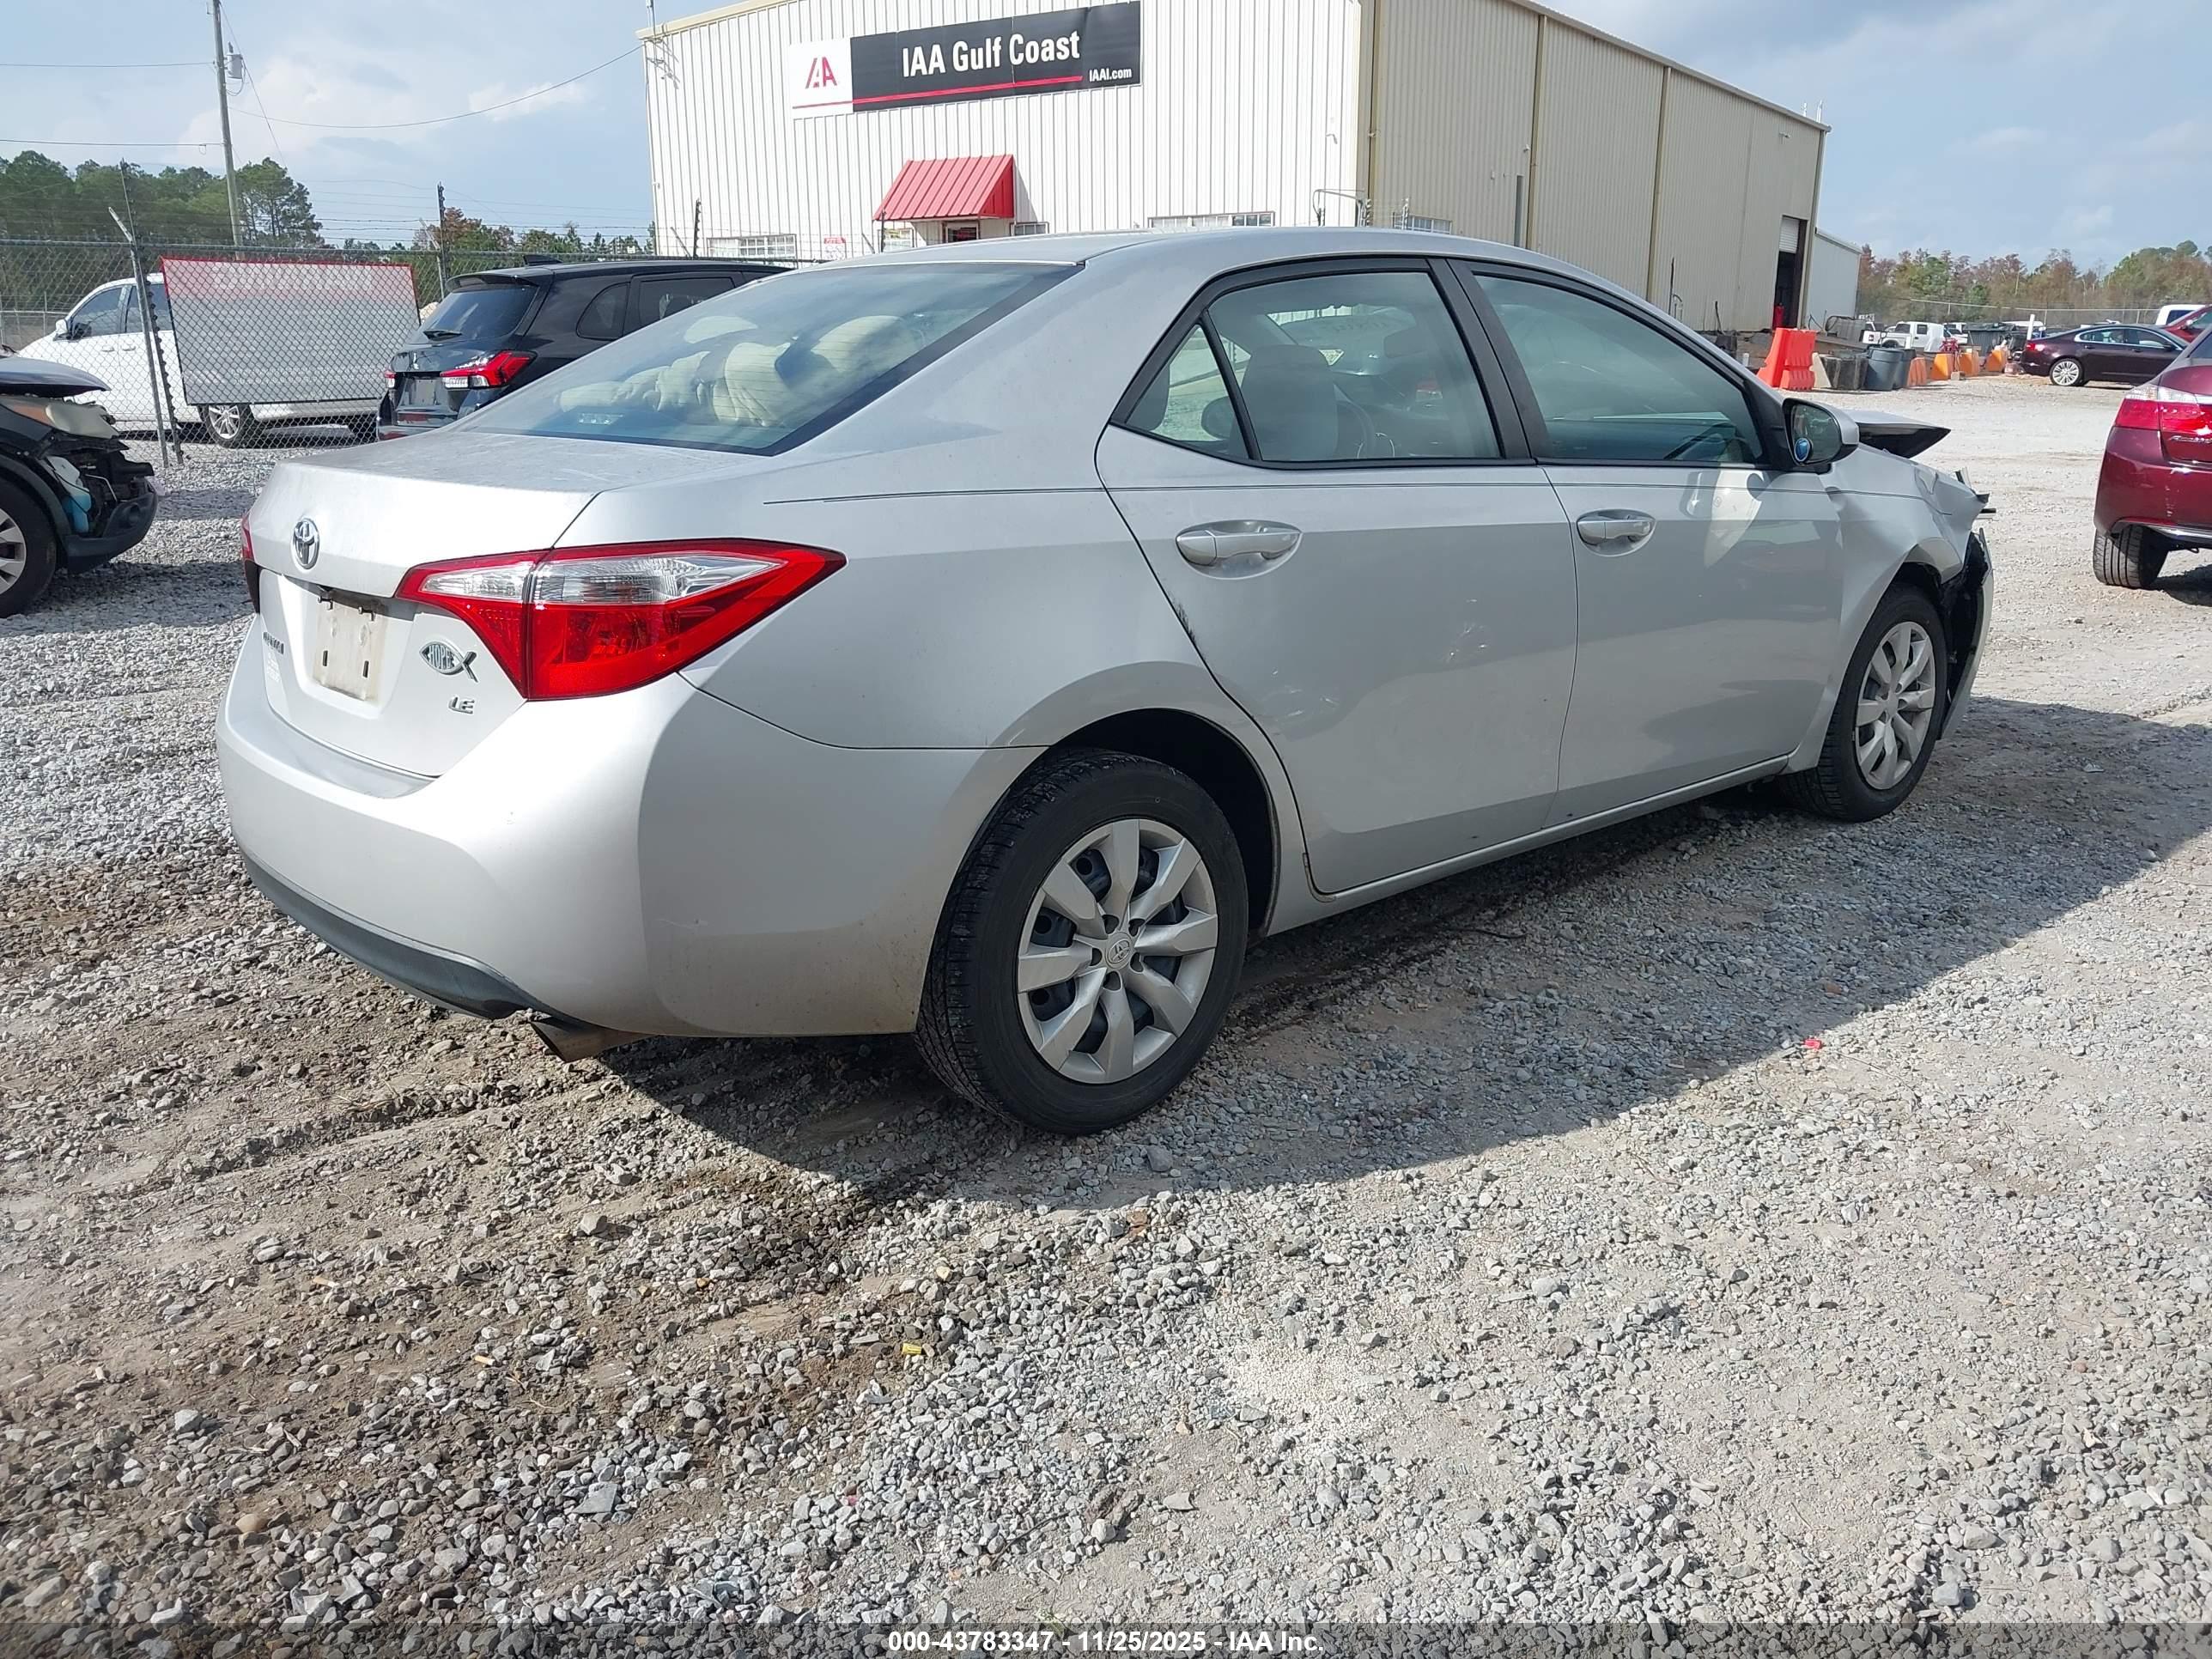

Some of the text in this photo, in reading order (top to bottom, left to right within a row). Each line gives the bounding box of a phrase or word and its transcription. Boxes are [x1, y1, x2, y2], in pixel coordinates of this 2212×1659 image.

[903, 30, 1080, 77] IAA Gulf Coast
[428, 645, 455, 669] HOPE
[448, 696, 475, 714] LE
